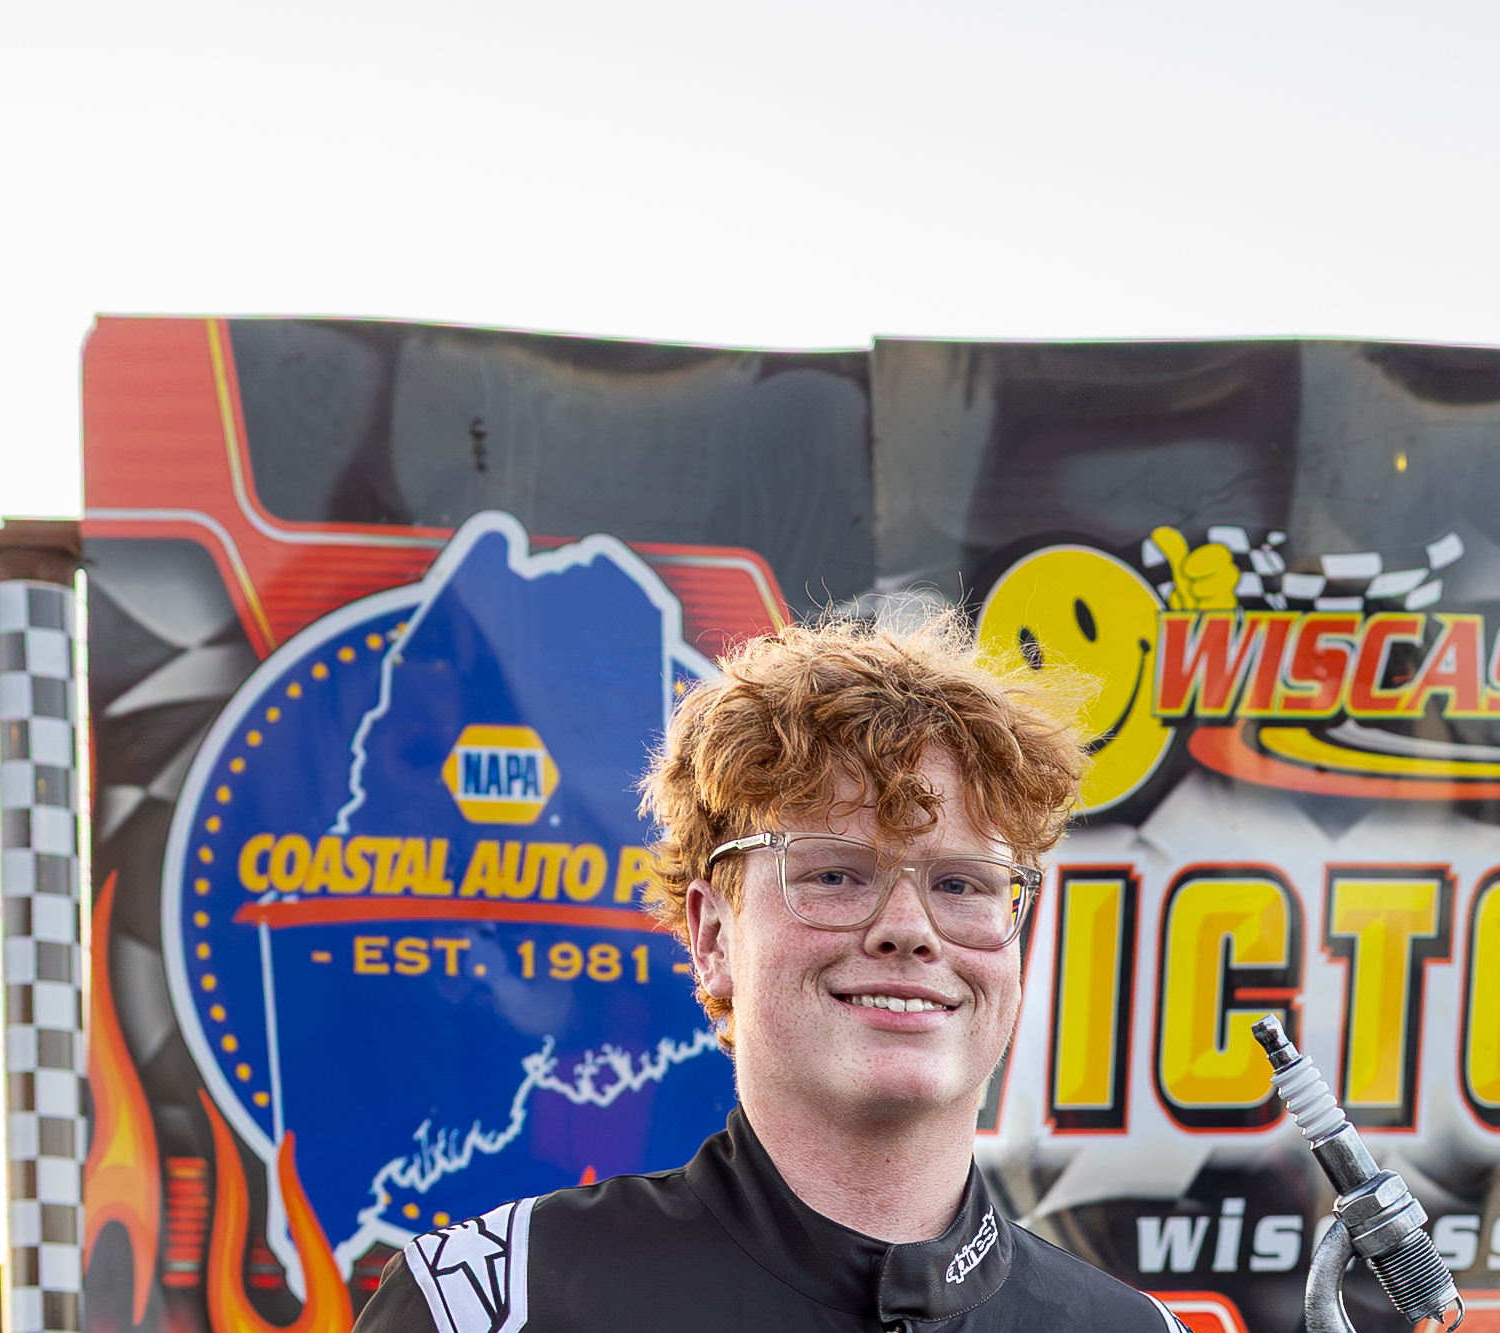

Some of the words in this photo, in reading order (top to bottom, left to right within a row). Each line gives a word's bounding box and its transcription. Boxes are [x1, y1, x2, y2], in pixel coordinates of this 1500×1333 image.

[459, 753, 543, 798] NAPA
[238, 833, 455, 898] COASTAL
[464, 840, 604, 901] AUTO
[353, 936, 486, 977] EST.
[517, 940, 651, 983] 1981
